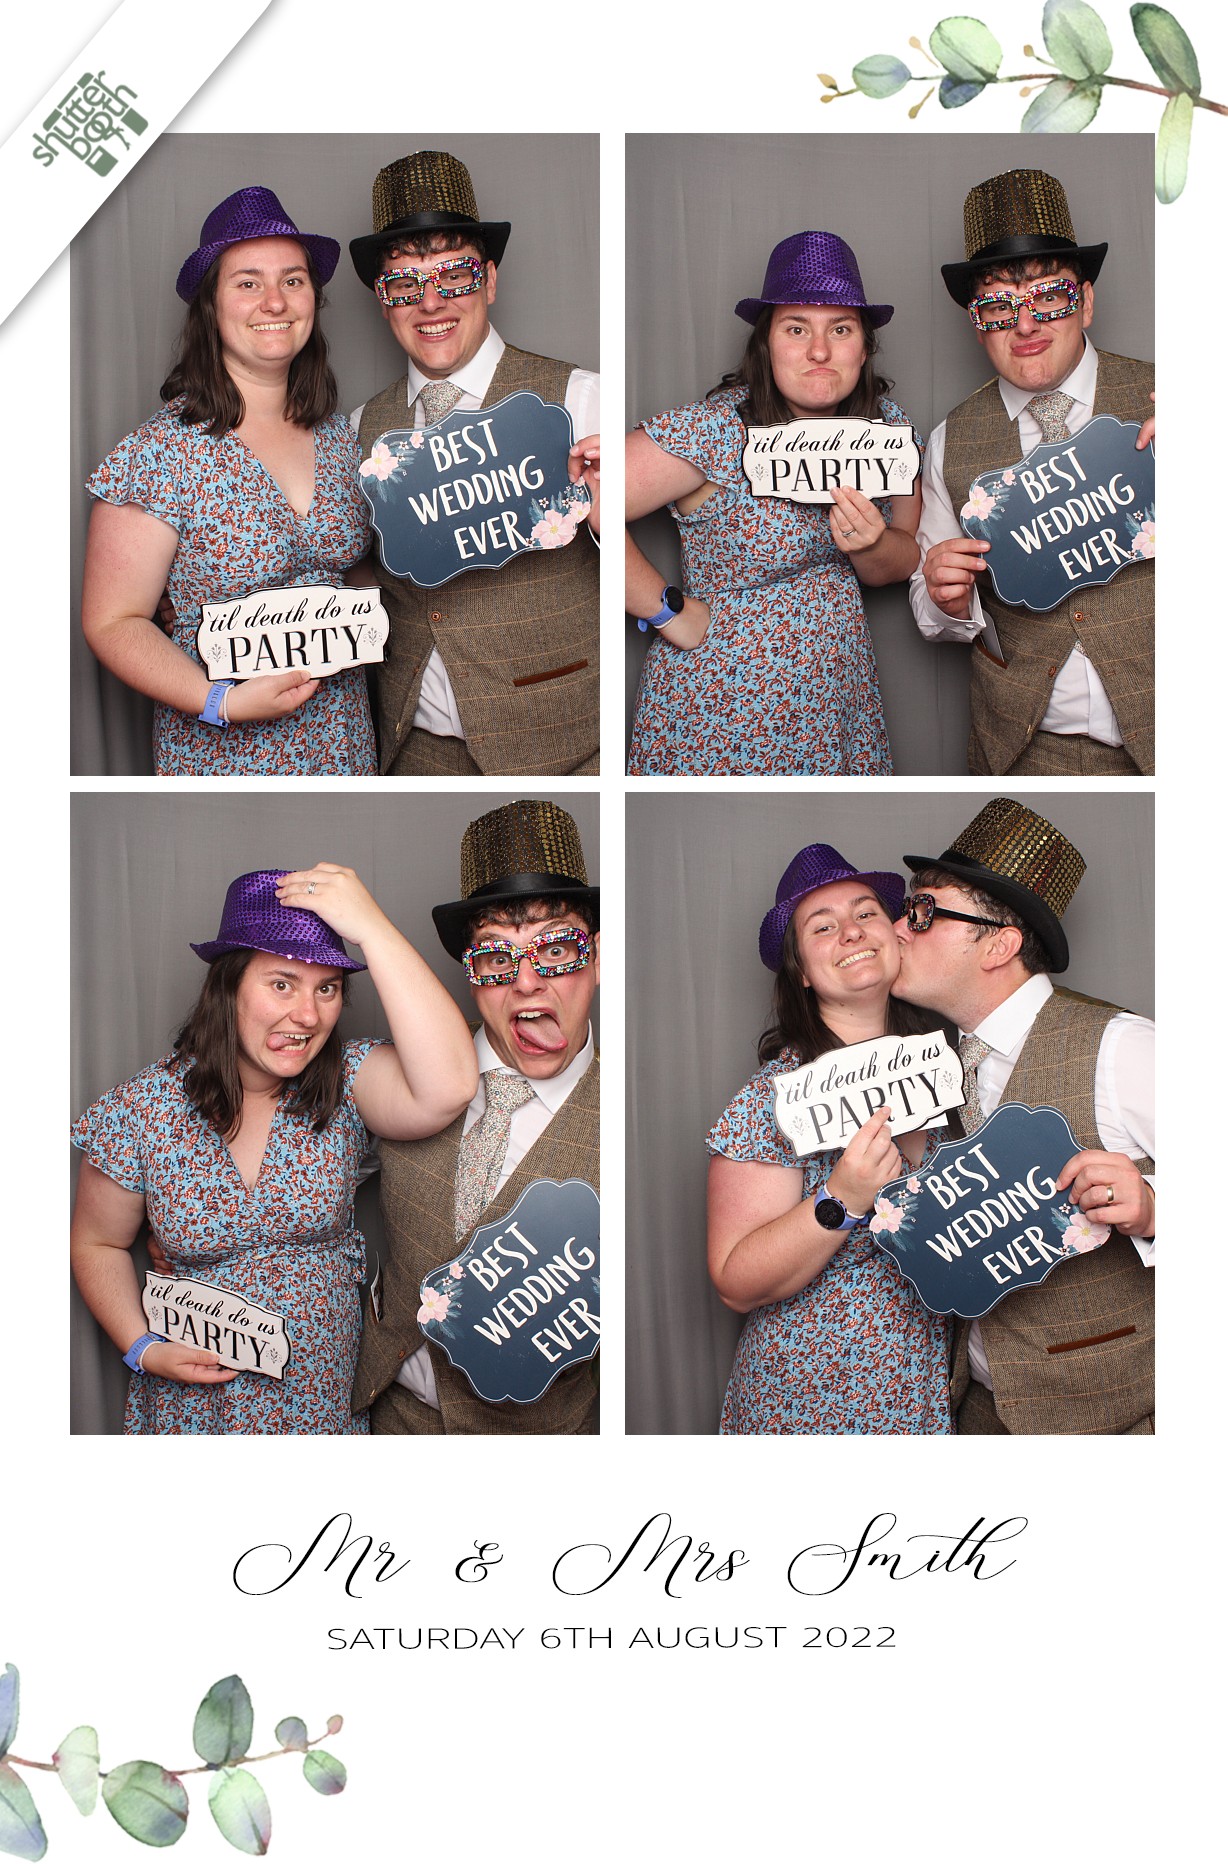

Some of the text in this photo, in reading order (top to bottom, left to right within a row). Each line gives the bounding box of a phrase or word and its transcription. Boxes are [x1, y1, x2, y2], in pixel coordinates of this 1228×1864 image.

[429, 418, 498, 472] BEST
[785, 429, 844, 452] death
[850, 429, 878, 450] do
[884, 436, 908, 449] us
[408, 455, 544, 525] WEDDING
[769, 458, 898, 492] PARTY
[1020, 447, 1086, 504] BEST
[454, 511, 528, 559] EVER
[1010, 474, 1135, 554] WEDDING
[1058, 528, 1130, 580] EVER
[245, 598, 309, 628] death
[315, 595, 345, 619] do
[351, 600, 377, 614] us
[227, 624, 367, 673] PARTY
[820, 1051, 880, 1093] death
[888, 1044, 915, 1072] do
[921, 1043, 944, 1062] us
[807, 1068, 941, 1145] PARTY
[925, 1143, 1000, 1210] BEST
[926, 1166, 1056, 1262] WEDDING
[467, 1221, 538, 1291] BEST
[983, 1226, 1062, 1284] EVER
[175, 1291, 223, 1318] death
[228, 1308, 252, 1326] do
[258, 1322, 279, 1335] us
[474, 1237, 595, 1345] WEDDING
[163, 1306, 270, 1369] PARTY
[531, 1298, 600, 1363] EVER
